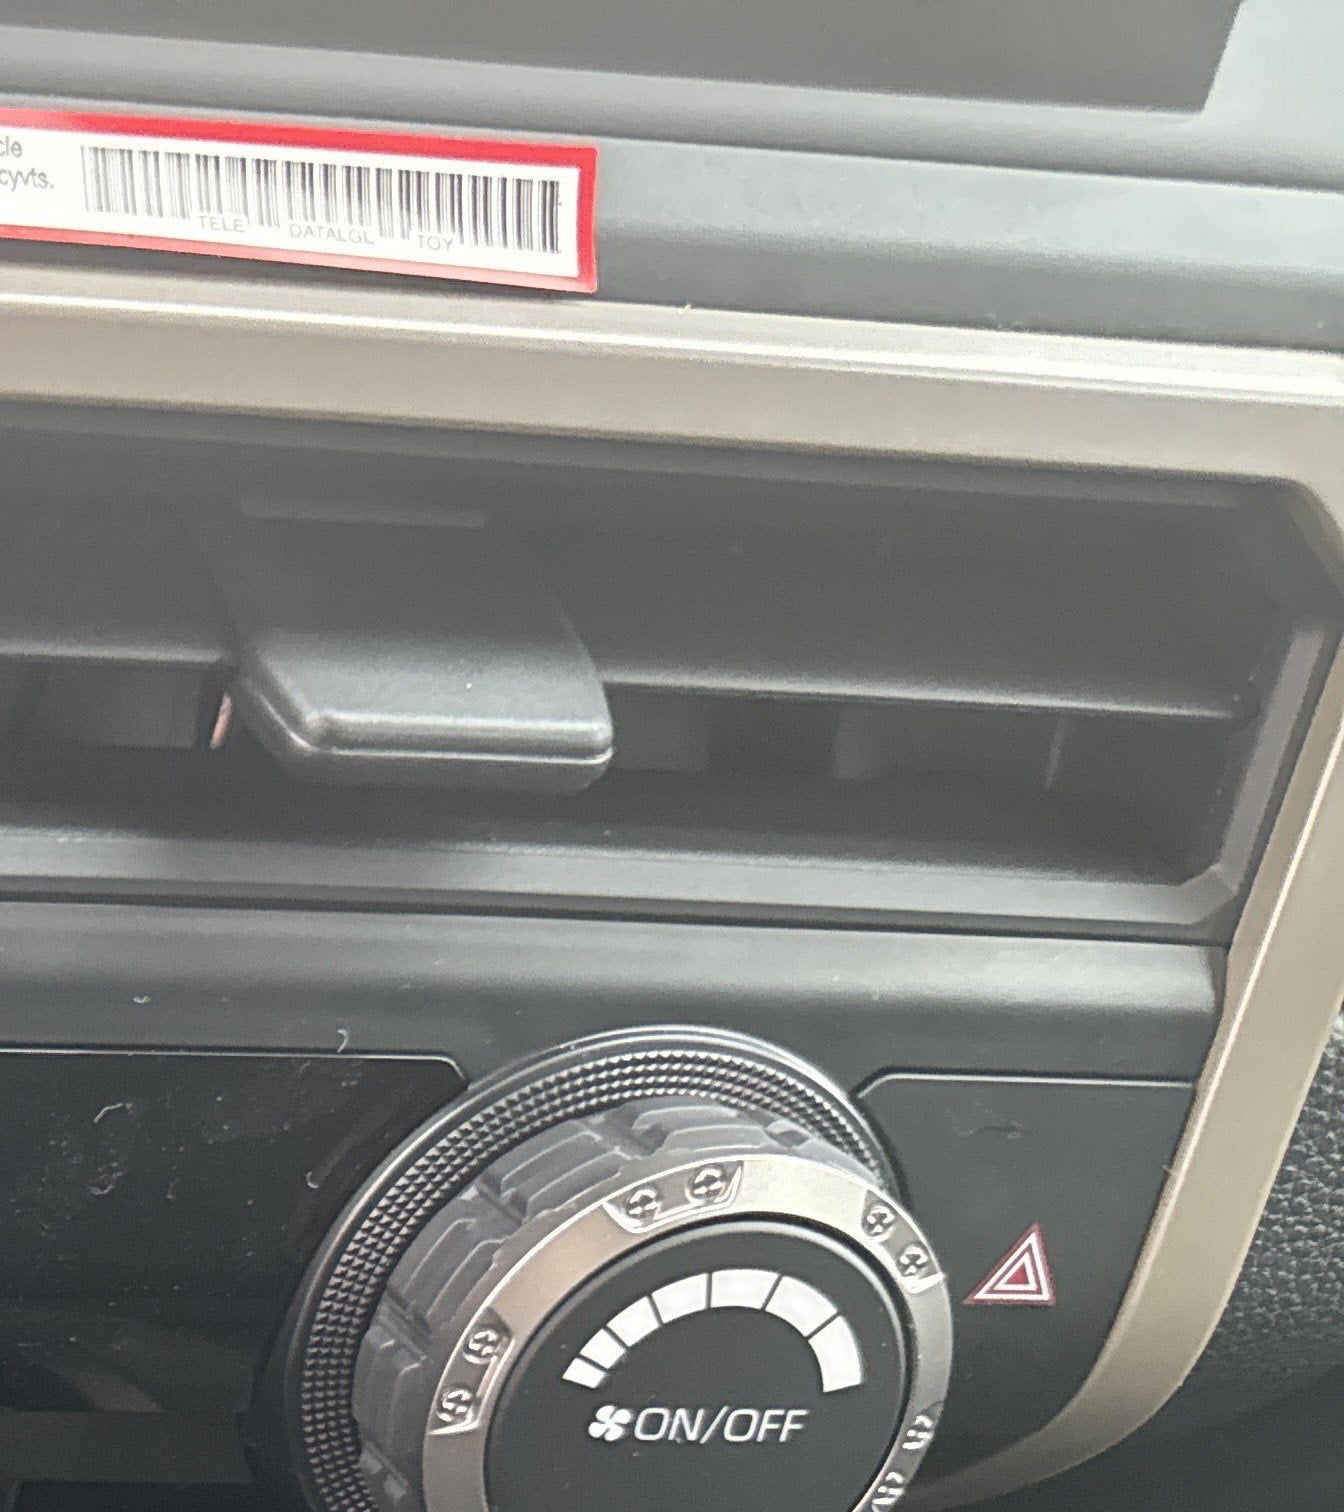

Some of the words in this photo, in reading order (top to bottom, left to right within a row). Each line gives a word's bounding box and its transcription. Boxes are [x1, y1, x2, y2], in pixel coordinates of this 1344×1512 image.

[198, 215, 246, 233] TELE
[417, 233, 454, 252] TOY
[633, 1406, 810, 1444] ON/OFF
